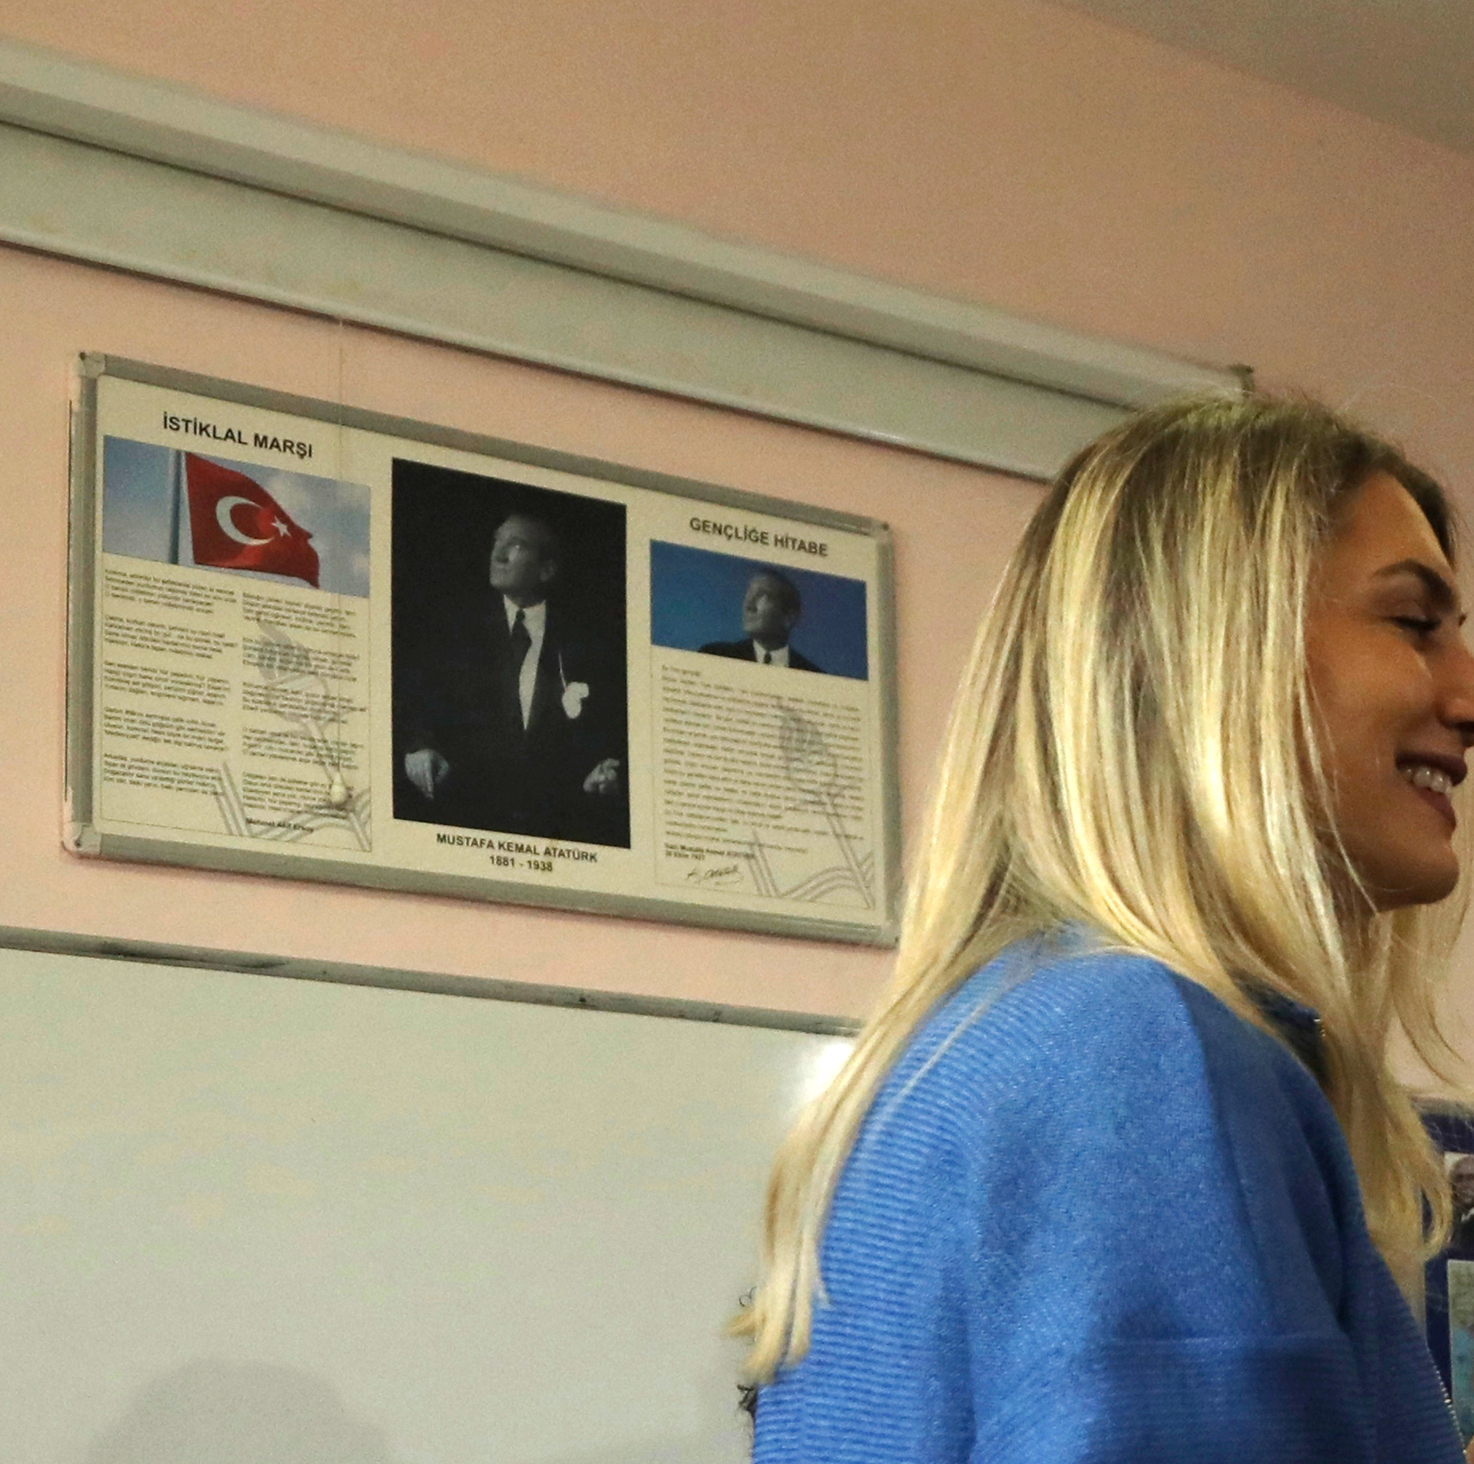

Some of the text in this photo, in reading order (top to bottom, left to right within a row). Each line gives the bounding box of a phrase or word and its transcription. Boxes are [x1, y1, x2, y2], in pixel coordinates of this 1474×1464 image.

[163, 411, 313, 460] İSTİKLAL MARŞI
[689, 516, 829, 557] GENÇLİĞE HİTABE
[436, 832, 598, 863] MUSTAFA KEMAL ATATÜRK
[489, 855, 515, 868] 1881
[527, 859, 553, 872] 1938
